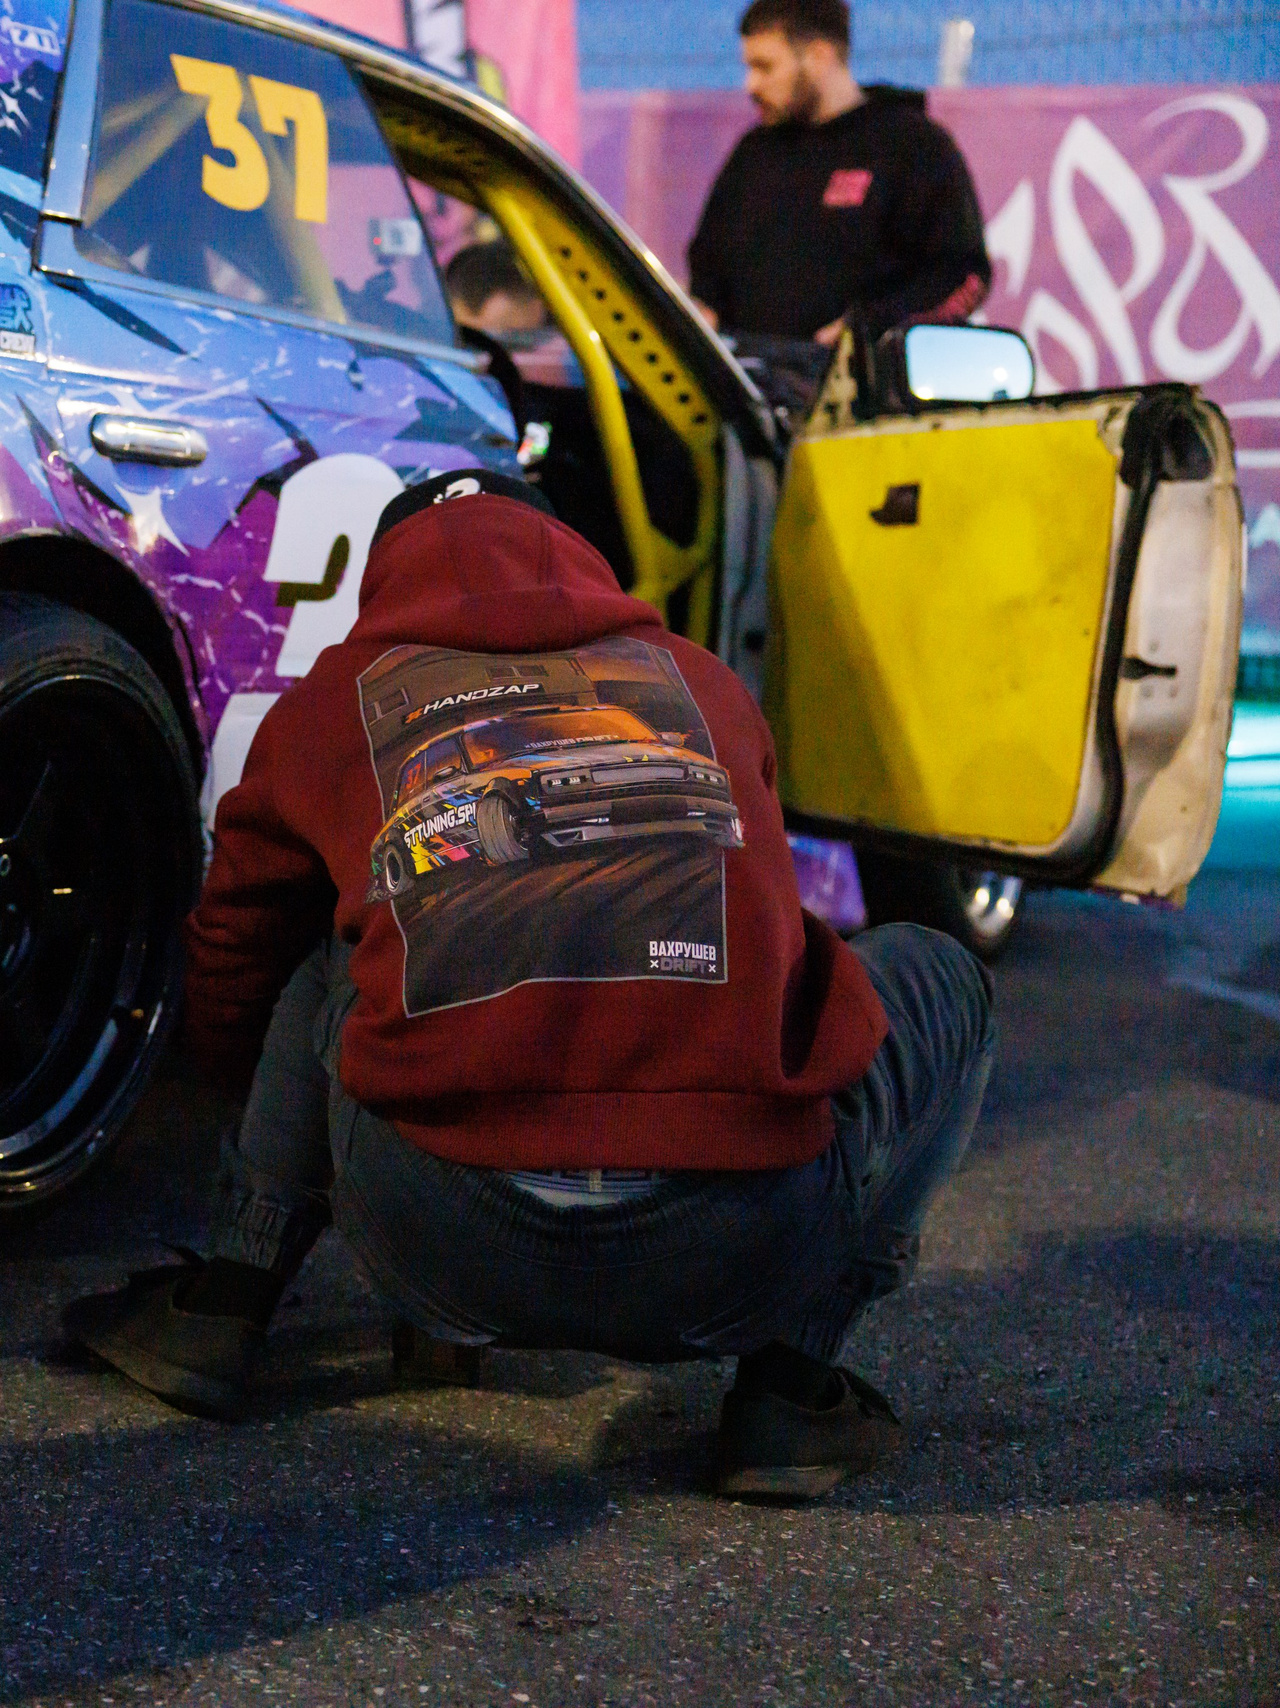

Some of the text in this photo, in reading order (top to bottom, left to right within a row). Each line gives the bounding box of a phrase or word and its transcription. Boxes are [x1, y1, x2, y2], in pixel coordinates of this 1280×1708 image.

[170, 53, 328, 223] 37
[423, 683, 540, 715] HANDZAP
[649, 941, 717, 961] ВАХРУШЕВ
[660, 957, 707, 974] DRIFT
